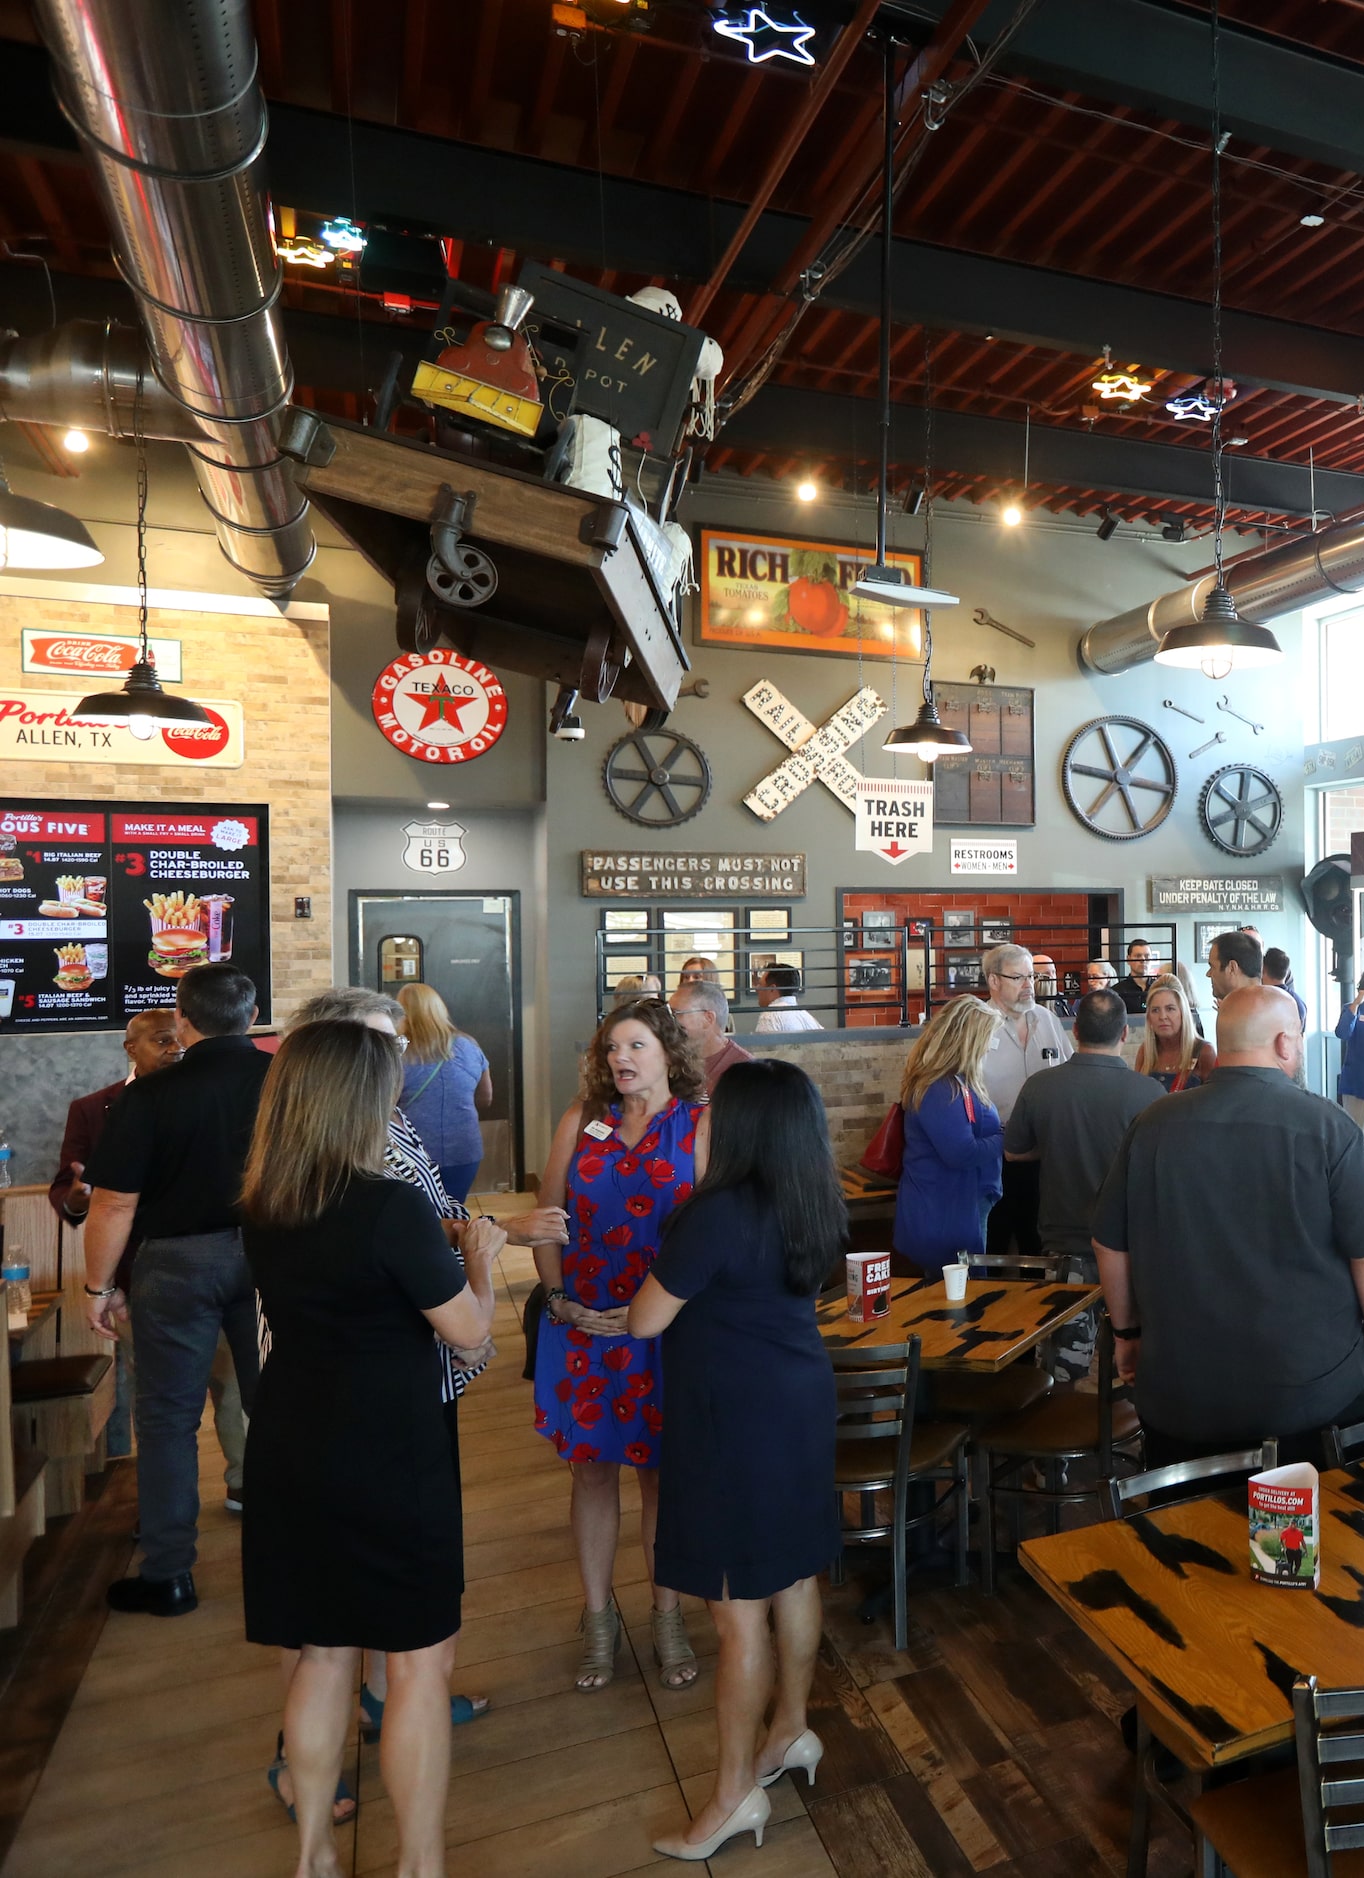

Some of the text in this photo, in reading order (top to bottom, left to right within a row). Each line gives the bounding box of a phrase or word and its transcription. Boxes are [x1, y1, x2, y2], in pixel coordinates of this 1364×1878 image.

[595, 326, 658, 377] LEN
[715, 546, 790, 585] RICH
[723, 588, 769, 601] TOMATOES
[380, 650, 503, 698] GASOLINE
[412, 681, 475, 696] TEXACO
[16, 728, 112, 747] ALLEN, TX
[378, 712, 503, 761] MOTOR OIL
[864, 798, 925, 818] TRASH
[47, 822, 89, 836] FIVE
[124, 823, 206, 833] MAKE IT A MEAL
[422, 827, 447, 837] ROUTE
[871, 820, 919, 838] HERE
[215, 833, 242, 845] LARGE
[420, 849, 450, 868] 66
[954, 849, 1014, 860] RESTROOMS
[115, 850, 201, 877] #3 DOUBLE
[150, 860, 244, 870] CHAR-BROILED
[593, 856, 801, 873] PASSENGERS MUST NOT
[961, 861, 1008, 871] WOMEN MEN
[150, 869, 250, 880] CHEESEBURGER
[600, 876, 794, 891] USE THIS CROSSING
[1180, 879, 1259, 891] KEEP GATE CLOSED
[1159, 892, 1277, 904] UNDER PENALTY OF THE LAW
[1253, 1491, 1305, 1506] PORTILLOS.COM
